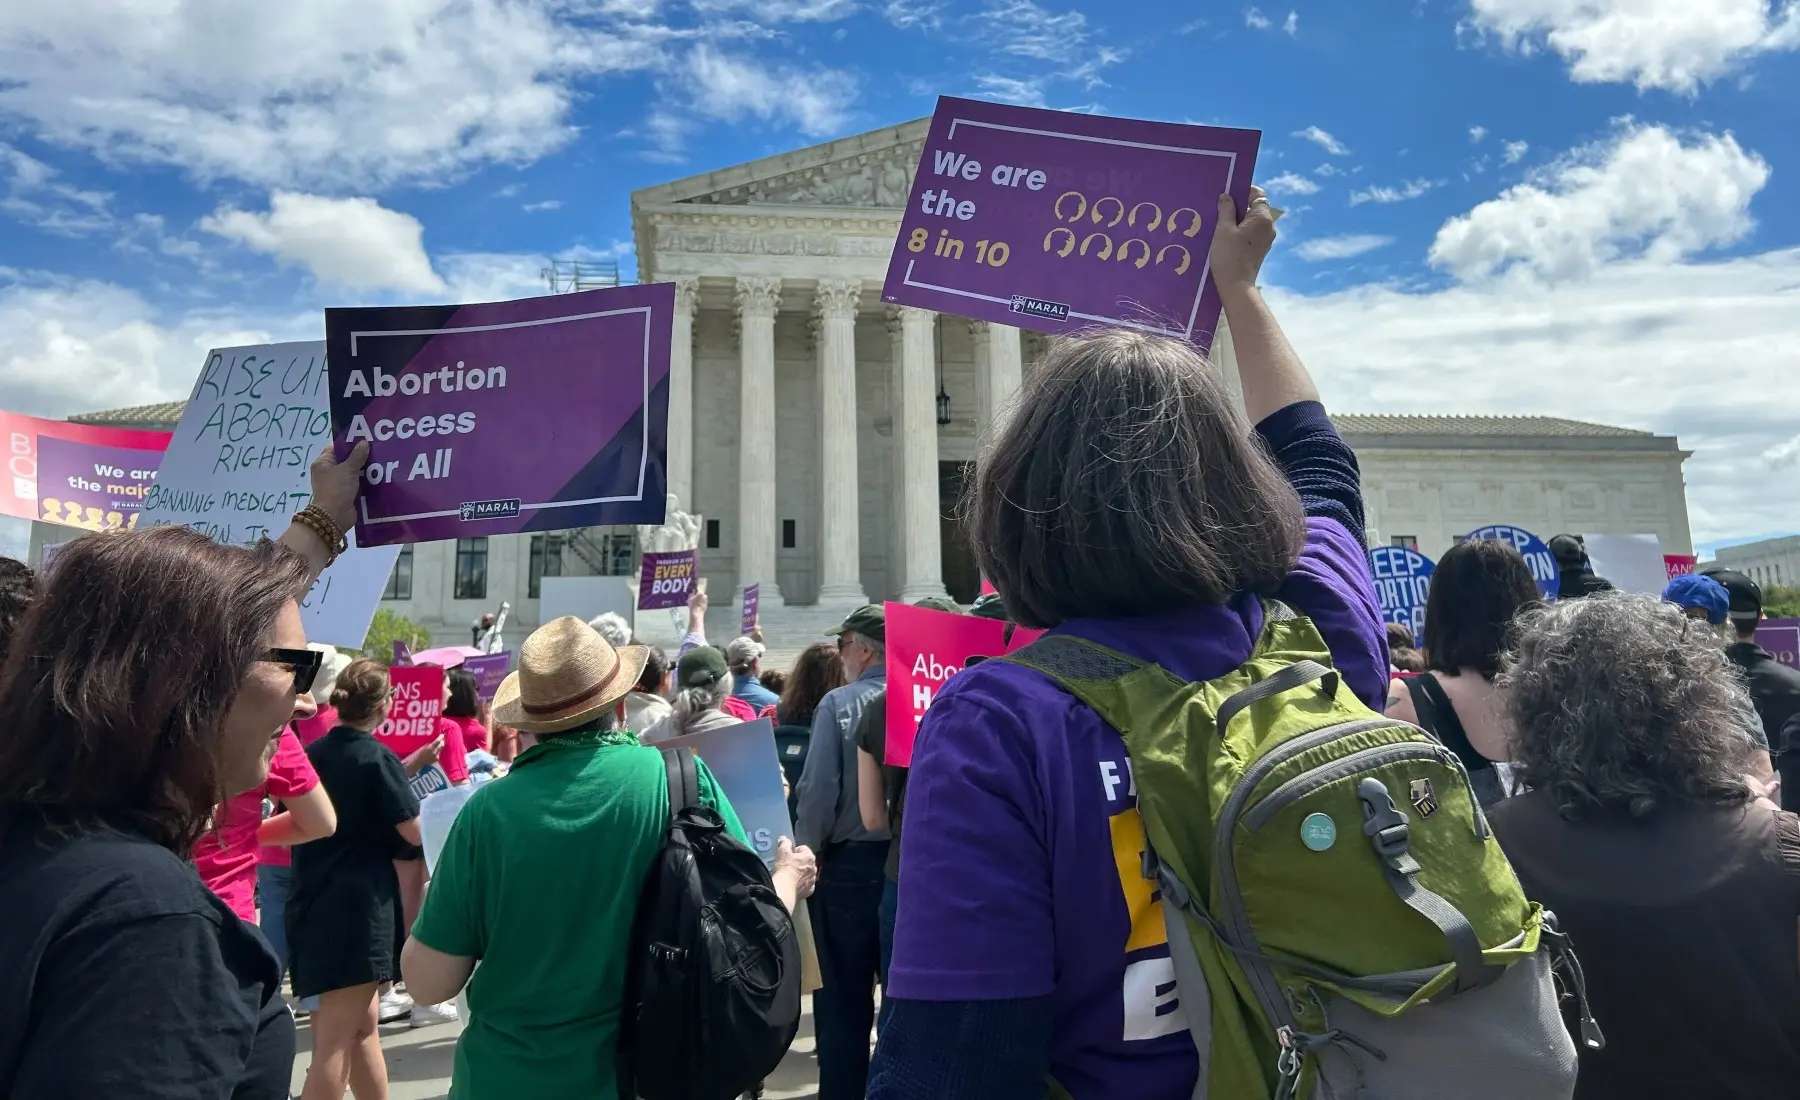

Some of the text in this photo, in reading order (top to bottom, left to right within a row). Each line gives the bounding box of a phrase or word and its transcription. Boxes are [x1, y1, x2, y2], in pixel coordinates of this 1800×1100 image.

[933, 150, 982, 182] We
[991, 164, 1047, 191] are
[921, 188, 976, 221] the
[907, 227, 928, 253] 8
[935, 229, 964, 260] in
[975, 239, 1010, 267] 10
[1027, 300, 1065, 315] NARAL
[196, 353, 275, 400] RISE
[343, 361, 507, 398] Abortion
[194, 402, 333, 443] ABORTIO
[346, 411, 476, 443] Access
[94, 463, 125, 478] We
[212, 443, 314, 478] RIGHTS!
[359, 448, 452, 485] or All
[68, 476, 101, 492] the
[146, 484, 314, 514] BANNING MEDICAT
[477, 502, 516, 513] NARAL
[654, 564, 693, 579] EVERY
[1371, 547, 1423, 578] EEP
[652, 577, 692, 595] BODY
[912, 652, 966, 681] Abo
[406, 699, 439, 718] OUR
[377, 717, 435, 737] ODIES
